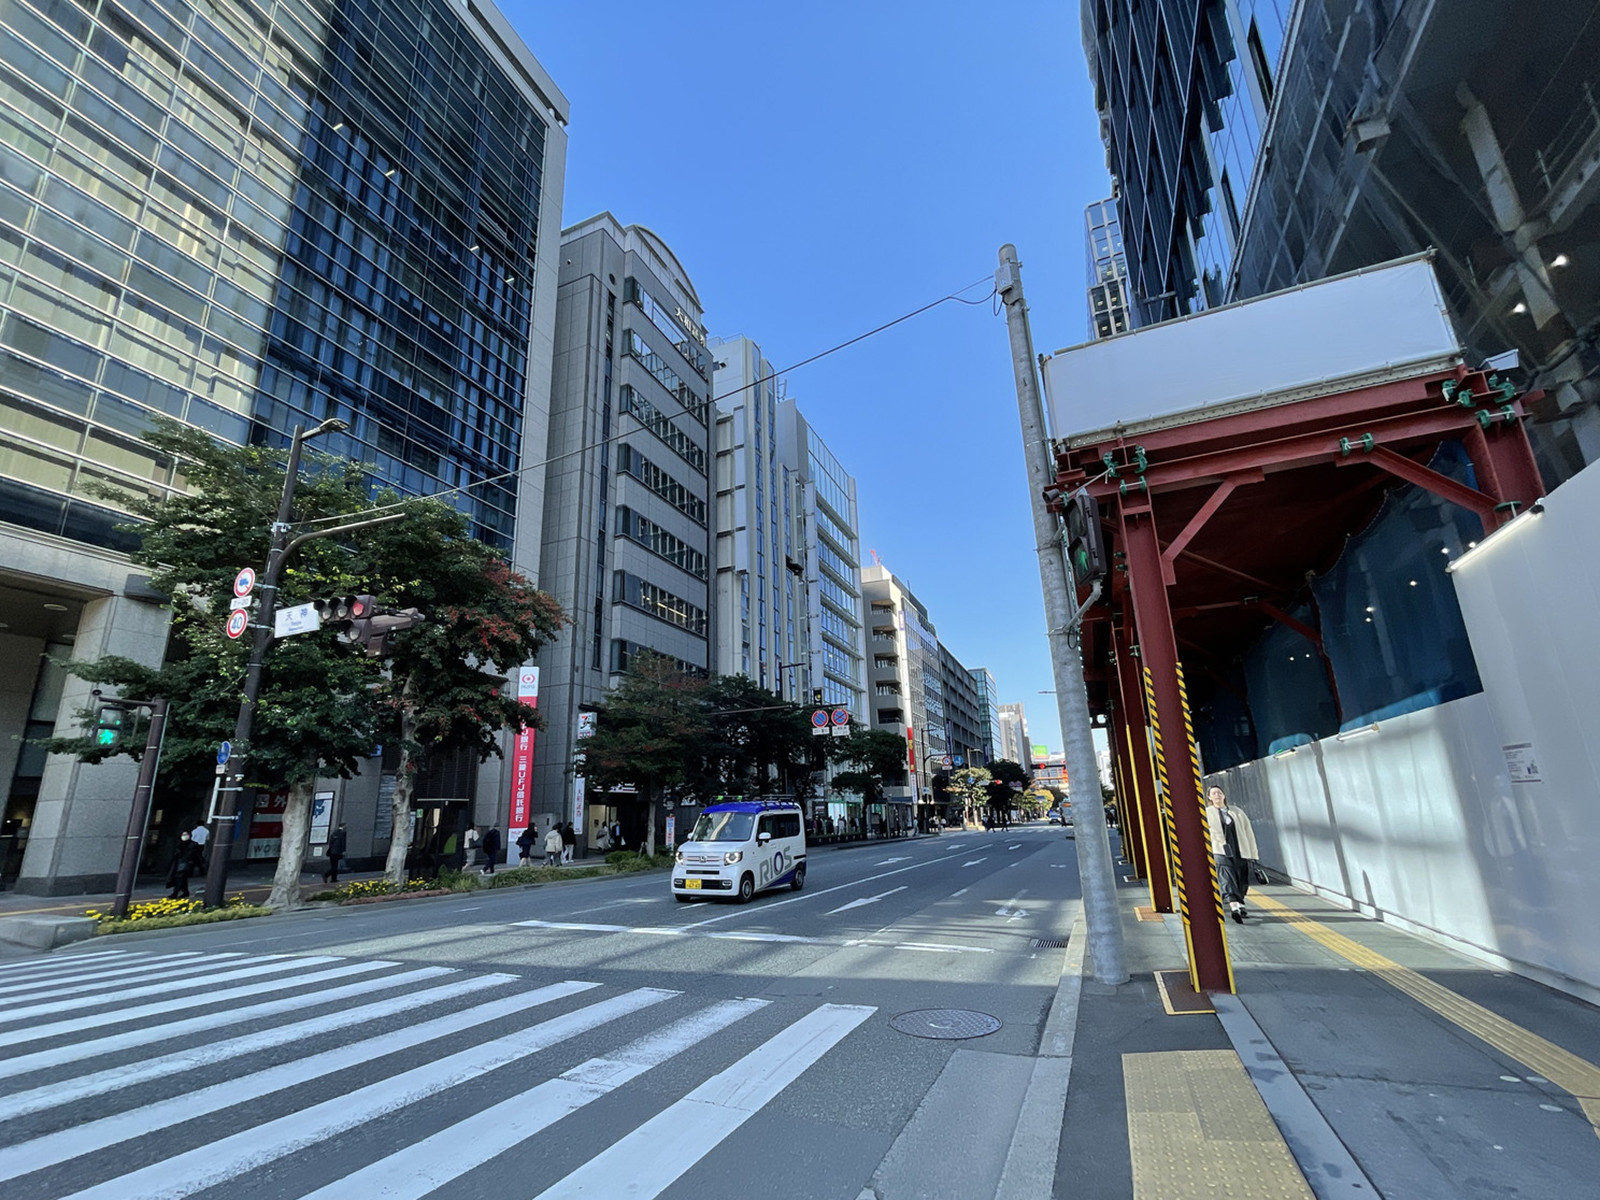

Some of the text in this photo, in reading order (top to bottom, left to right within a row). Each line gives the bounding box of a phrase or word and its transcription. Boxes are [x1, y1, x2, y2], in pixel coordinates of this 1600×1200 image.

[231, 616, 243, 630] 40
[285, 607, 308, 621] 天神
[515, 755, 528, 823] 三菱UFJ信託銀行
[760, 845, 793, 886] RIOS
